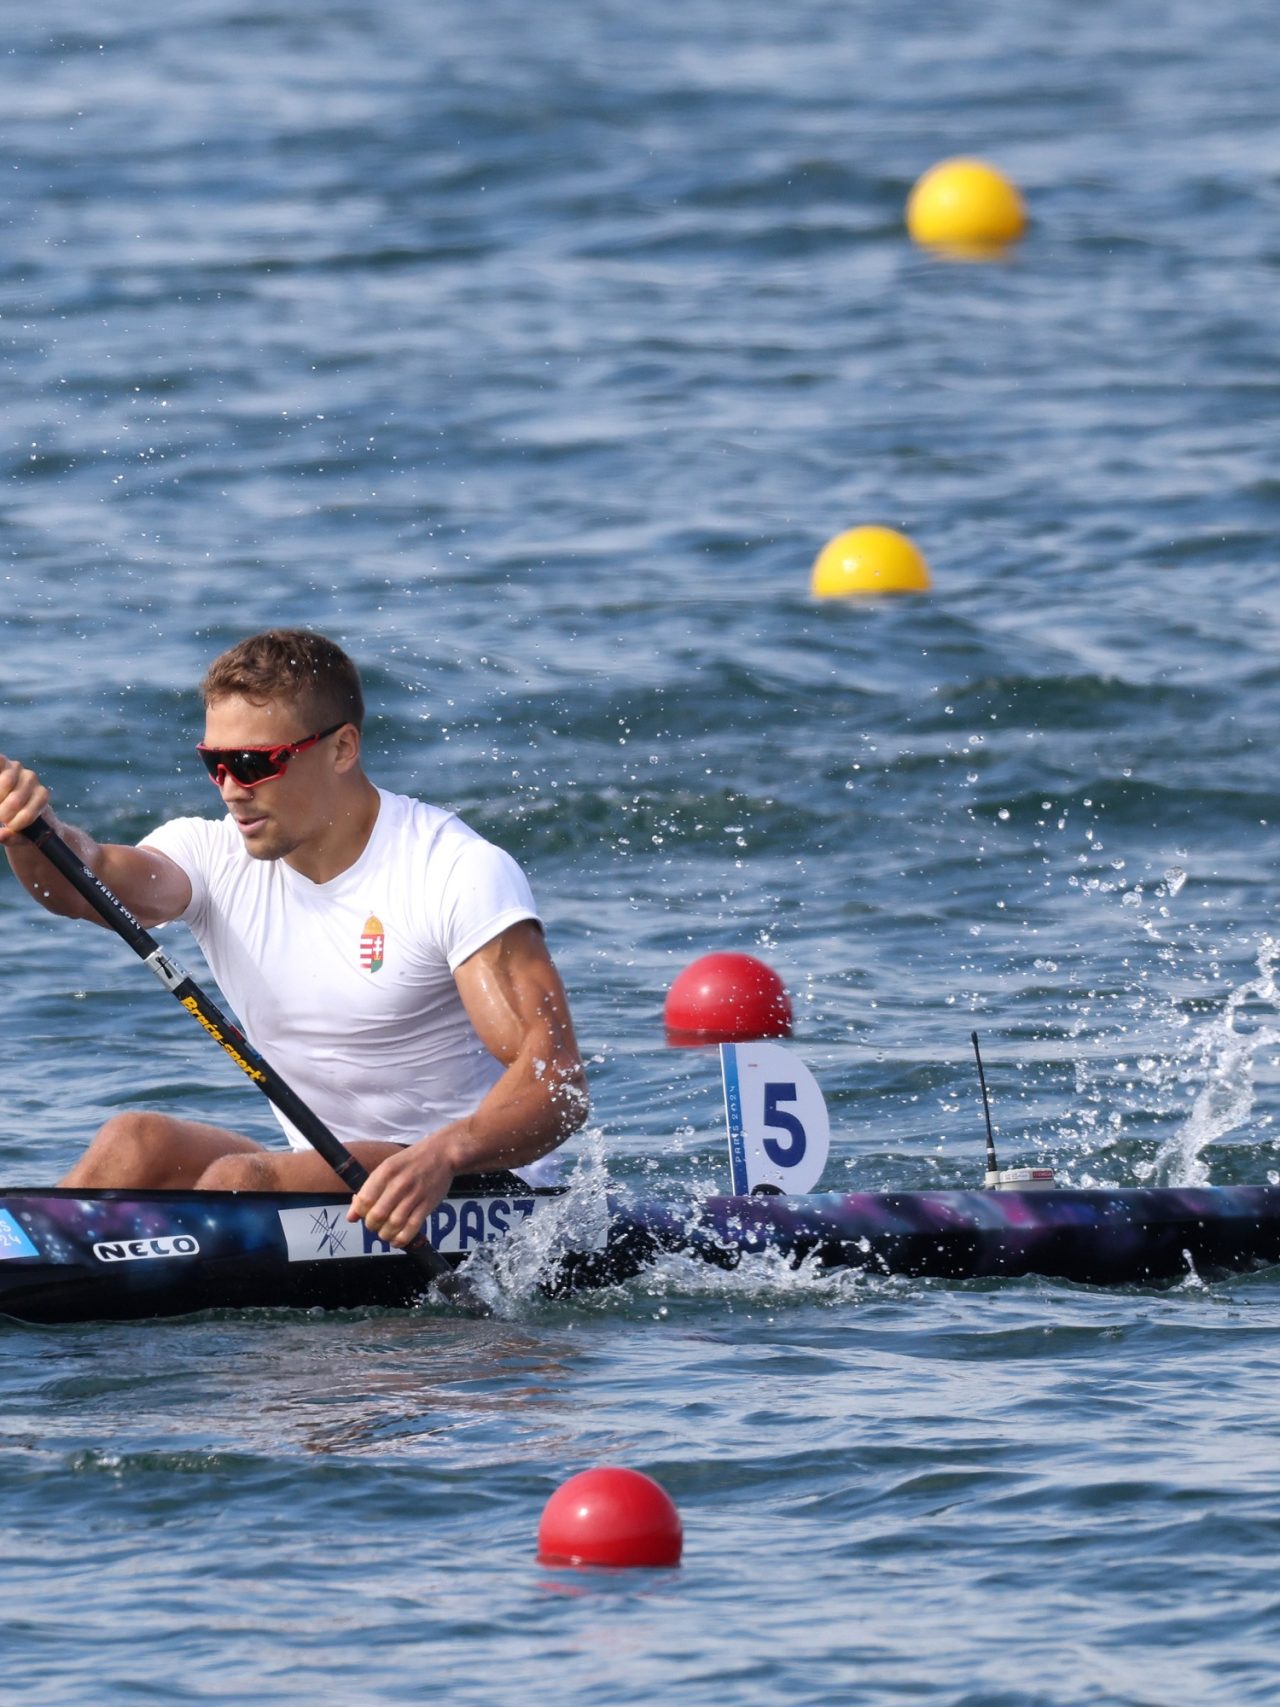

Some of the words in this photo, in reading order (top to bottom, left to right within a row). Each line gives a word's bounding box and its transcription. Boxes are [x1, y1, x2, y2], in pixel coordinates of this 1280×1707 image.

[95, 880, 119, 906] PARIS
[119, 905, 141, 930] 2024
[729, 1085, 739, 1120] 2024
[763, 1082, 807, 1168] 5
[97, 1237, 196, 1260] NELO
